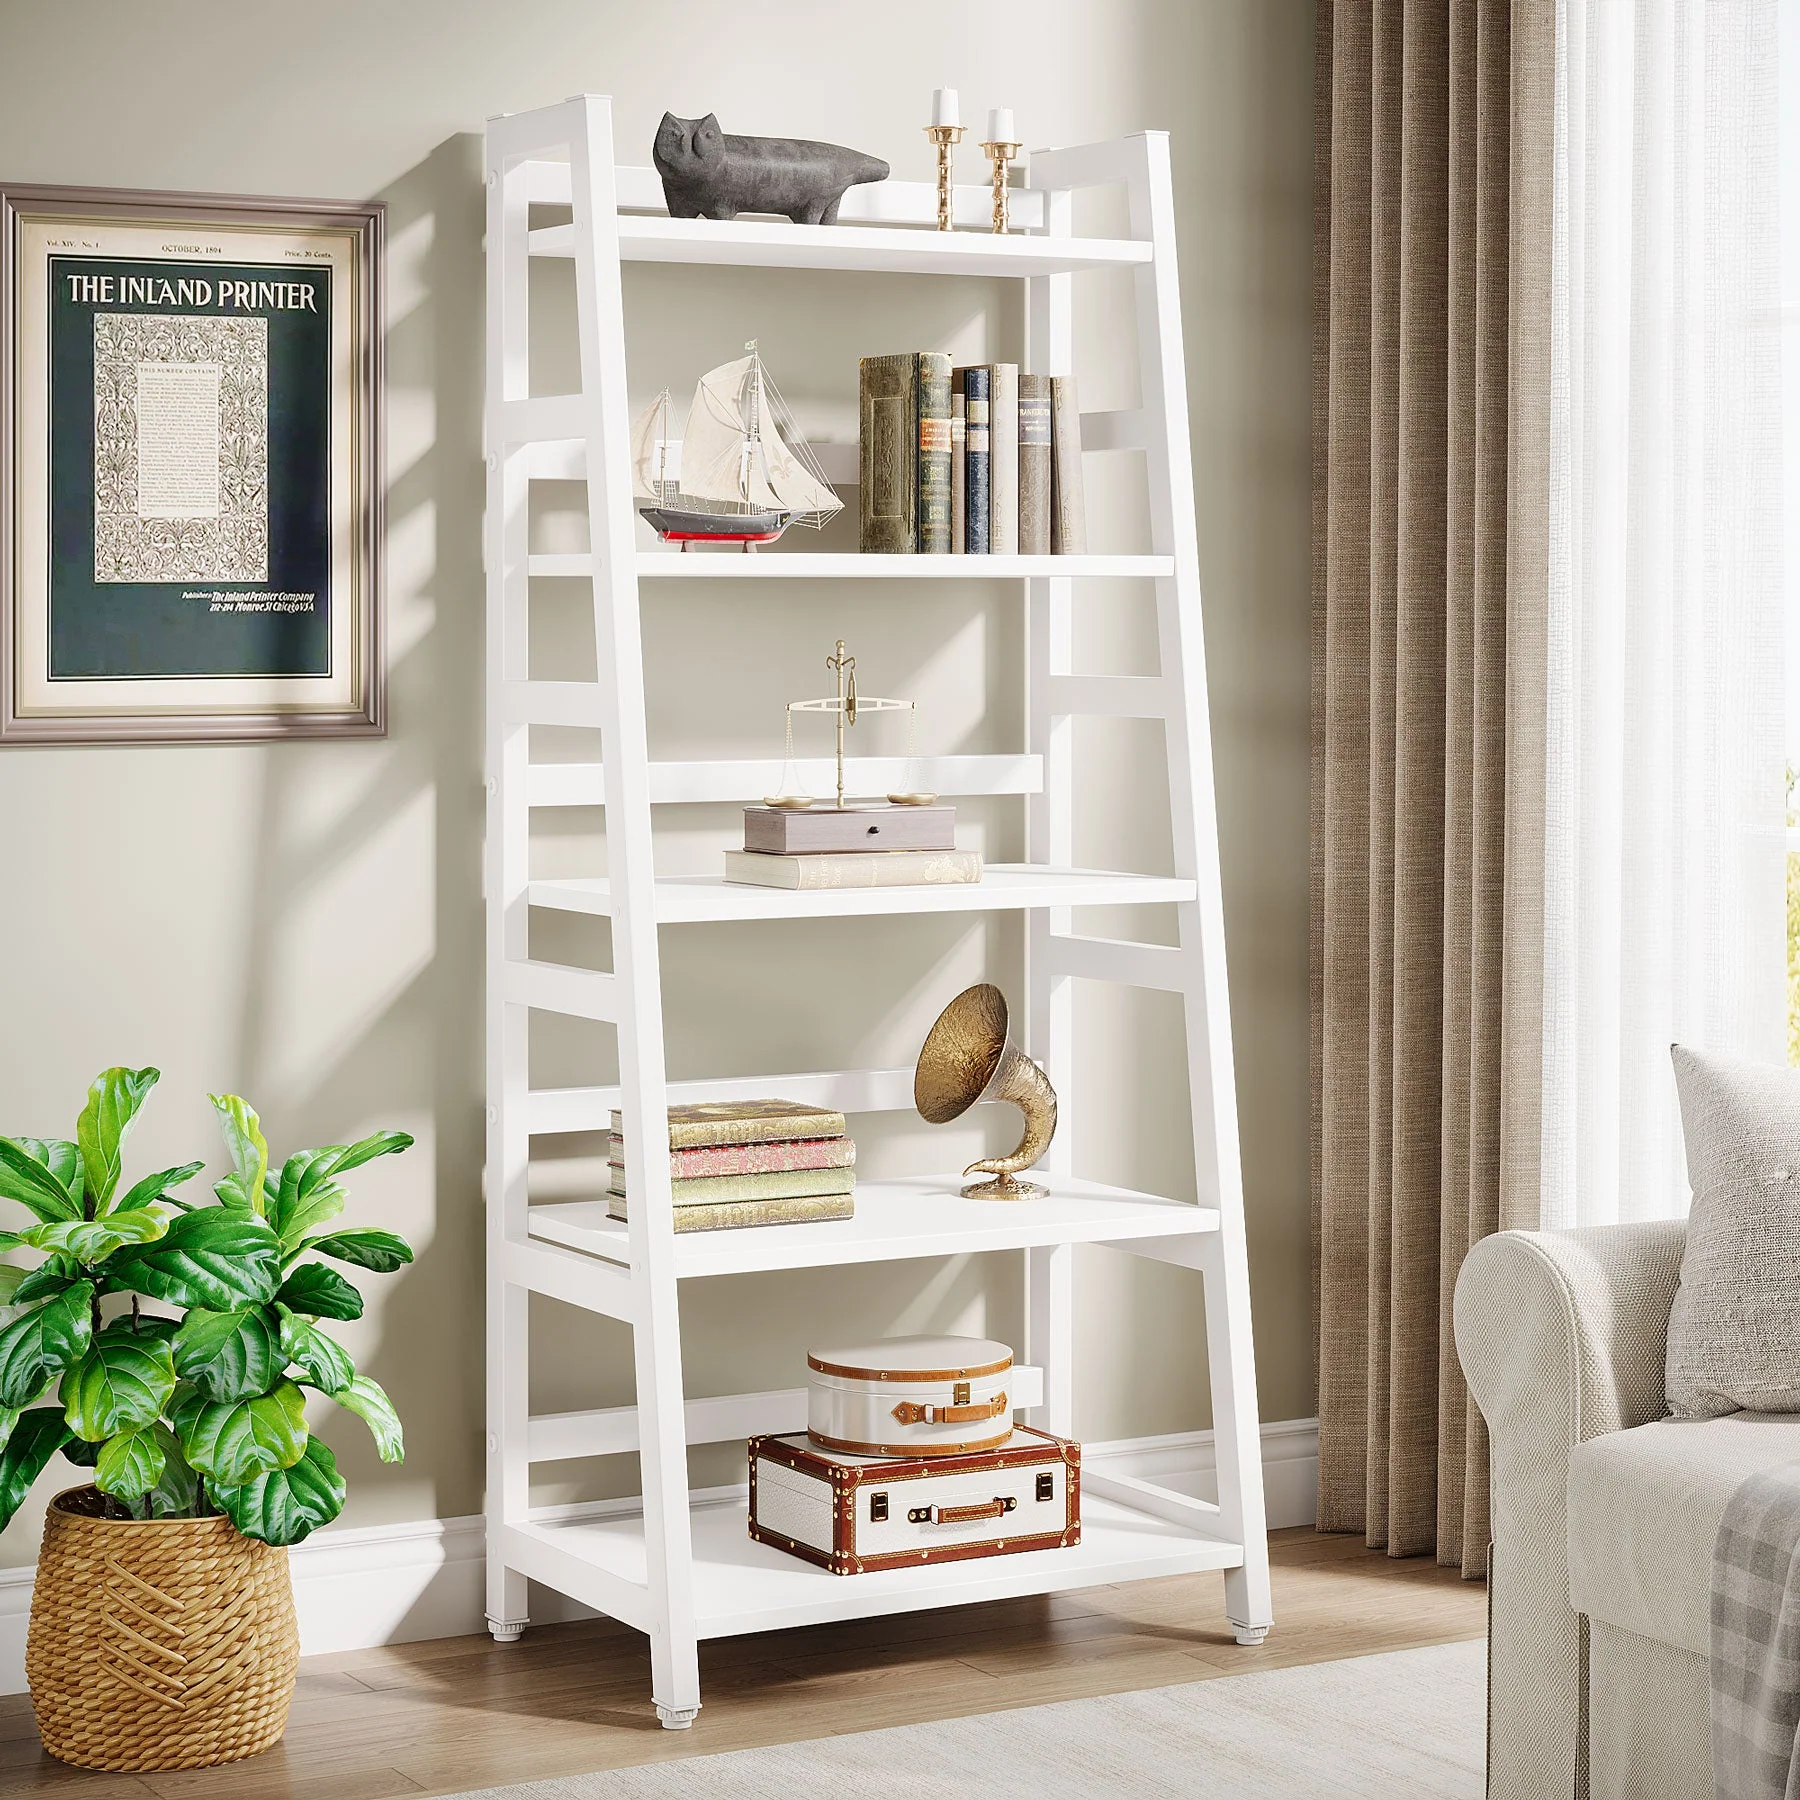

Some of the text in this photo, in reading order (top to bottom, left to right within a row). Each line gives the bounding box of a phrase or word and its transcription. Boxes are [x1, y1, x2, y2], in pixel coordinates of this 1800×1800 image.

[67, 274, 318, 314] THE INLAND PRINTER
[211, 591, 226, 602] The
[224, 591, 251, 602] Inland
[249, 591, 279, 602] Printer
[278, 591, 315, 603] Company
[233, 601, 265, 612] Monroe
[272, 601, 300, 614] Chicago
